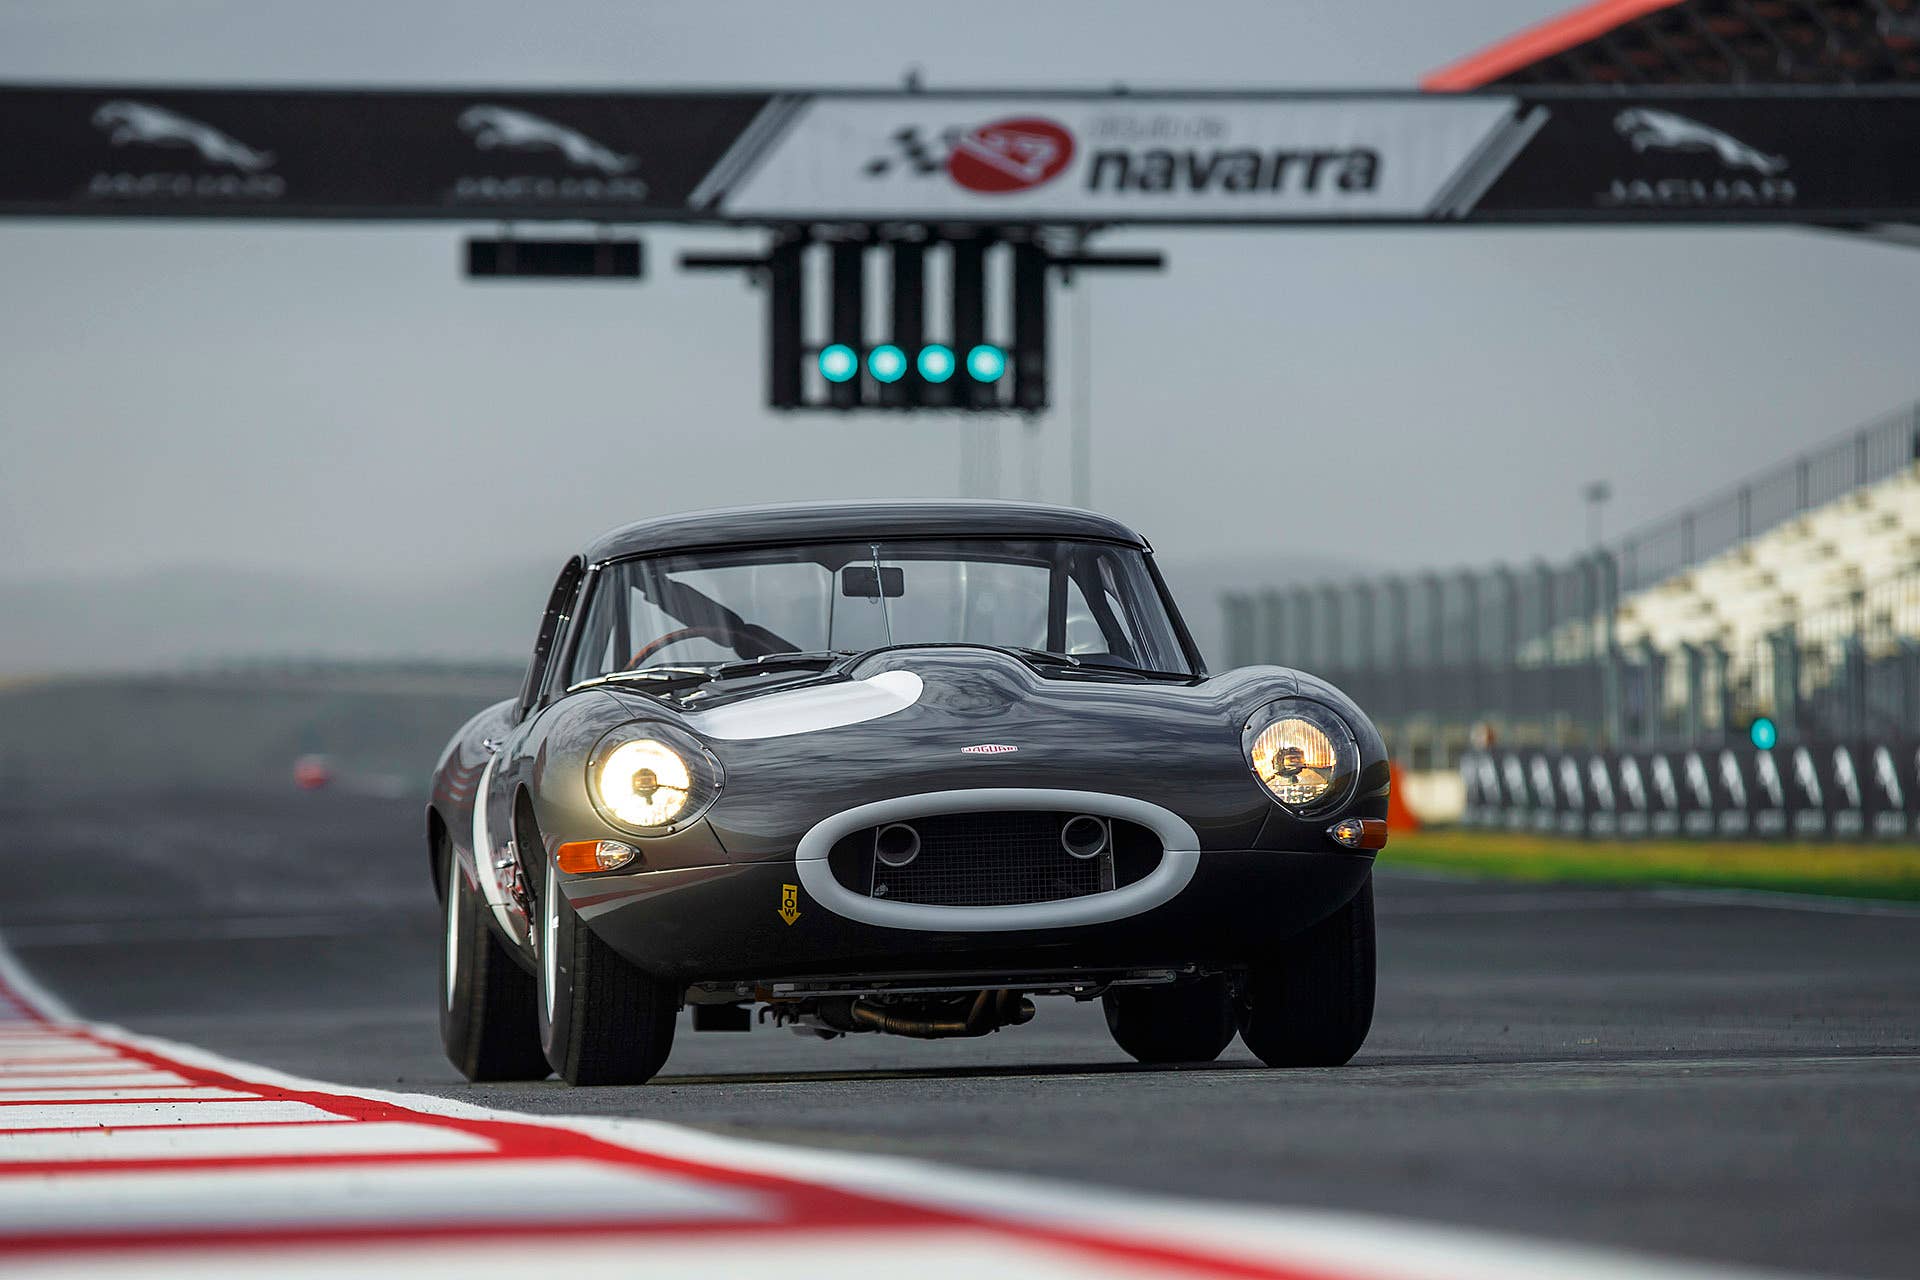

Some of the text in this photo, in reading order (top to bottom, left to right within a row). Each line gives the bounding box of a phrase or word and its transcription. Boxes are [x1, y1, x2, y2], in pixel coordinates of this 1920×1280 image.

[1087, 148, 1381, 192] navarra
[963, 745, 1017, 754] JAGUAR
[784, 888, 796, 917] TOW
